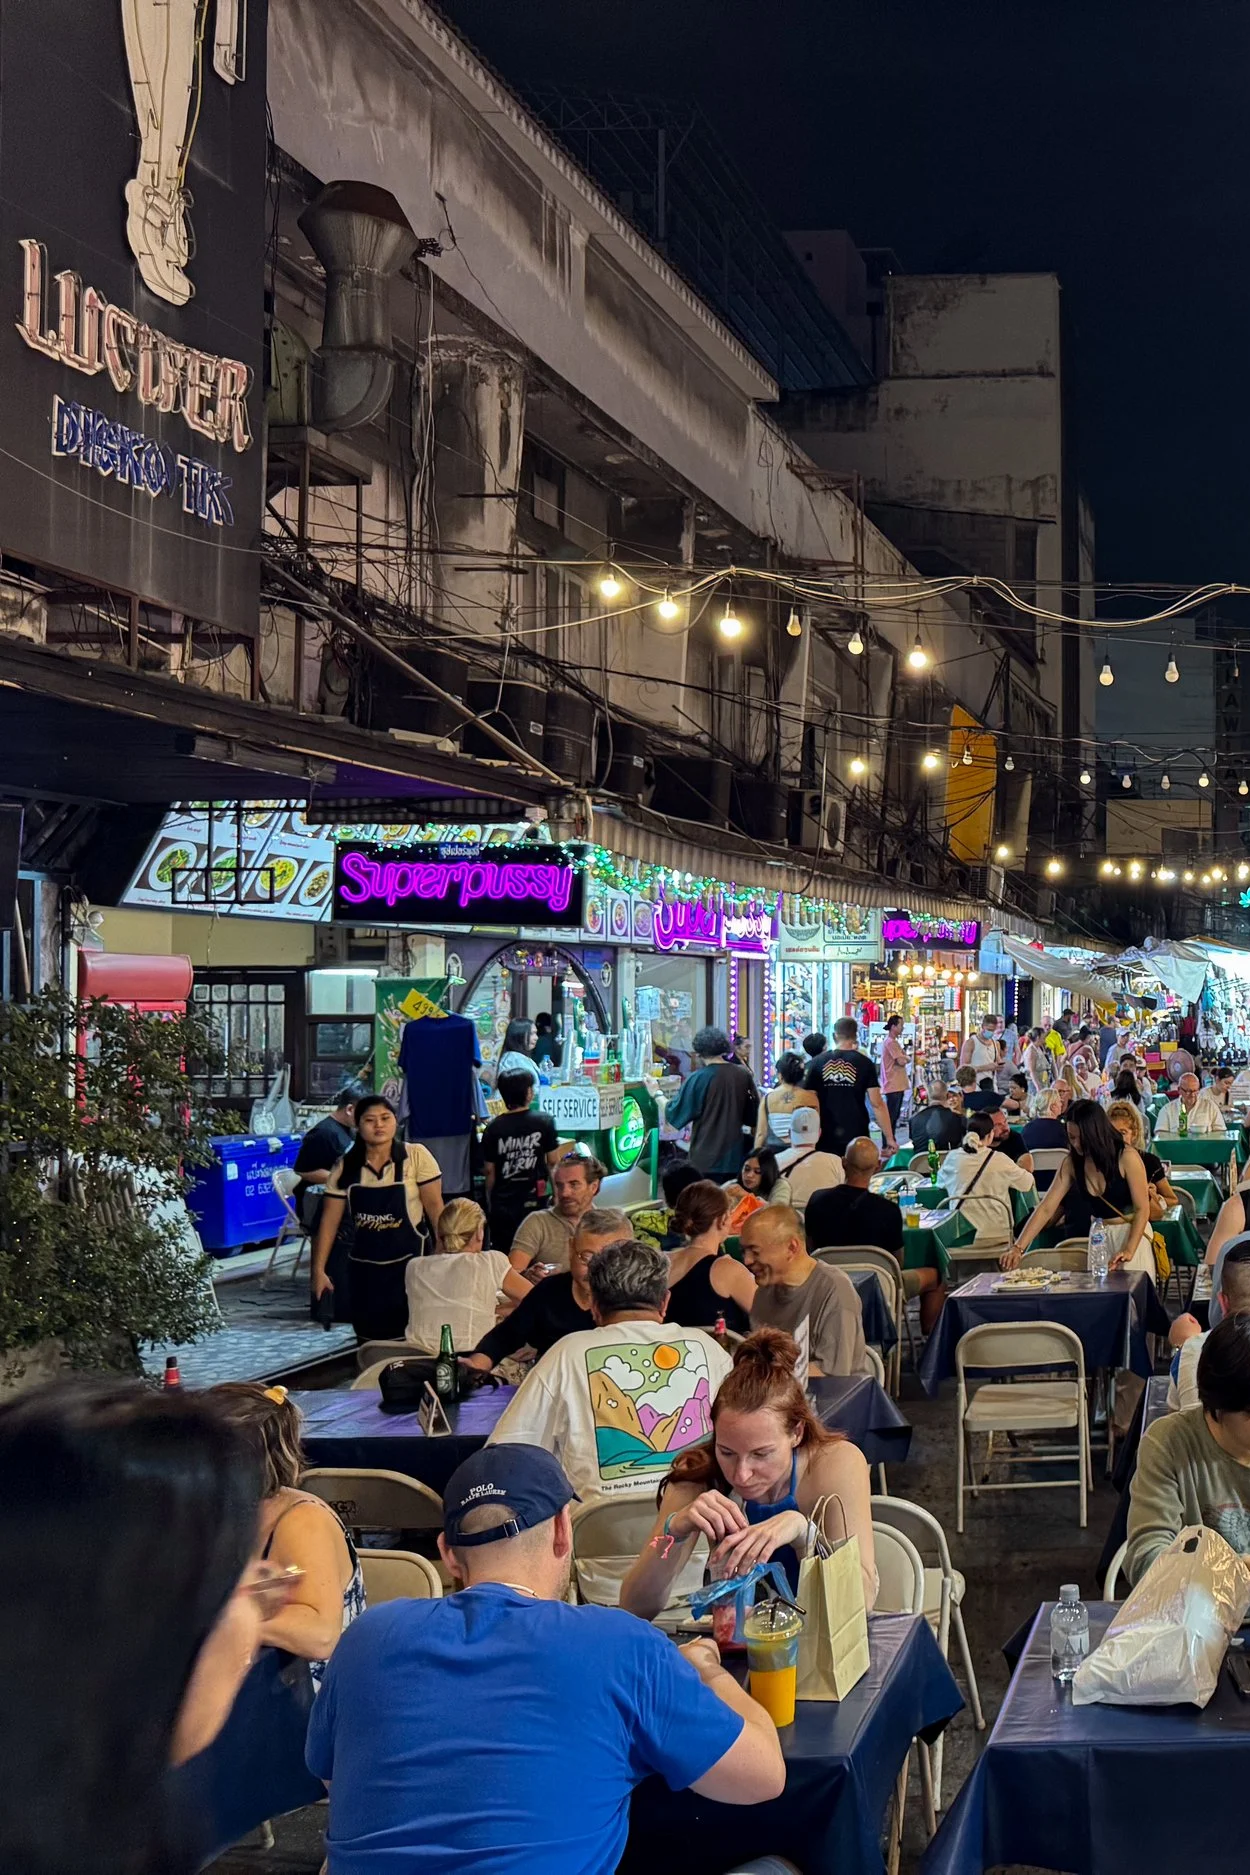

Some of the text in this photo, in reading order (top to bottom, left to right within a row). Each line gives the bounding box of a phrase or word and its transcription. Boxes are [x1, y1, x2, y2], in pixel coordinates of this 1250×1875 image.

[15, 238, 253, 452] LUCIFER
[340, 852, 574, 912] Superpussy
[542, 1097, 598, 1119] SELF SERVICE
[469, 1483, 495, 1497] POLO
[613, 1481, 632, 1490] Rocky
[460, 1492, 481, 1506] RALPH
